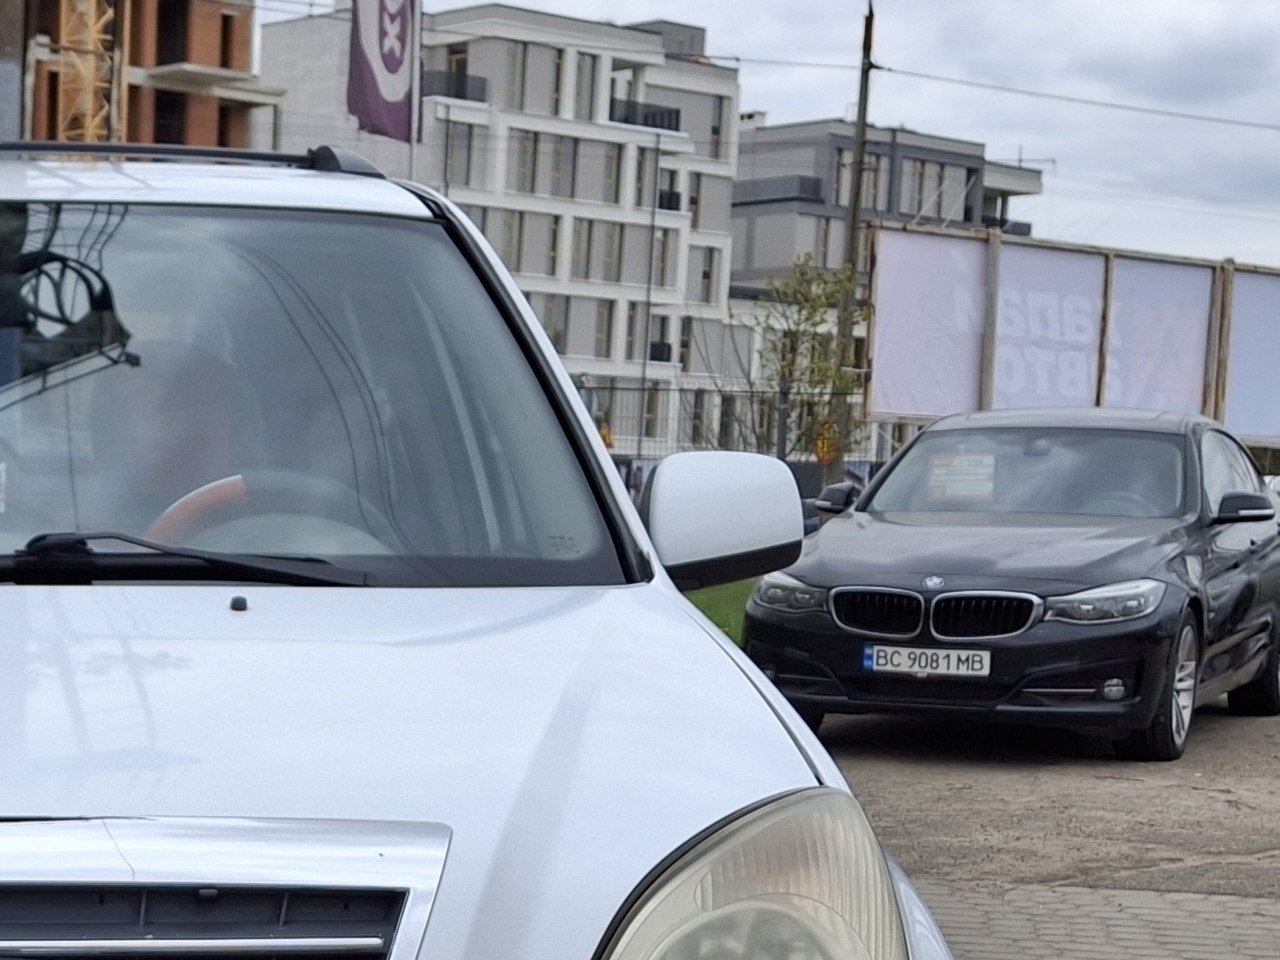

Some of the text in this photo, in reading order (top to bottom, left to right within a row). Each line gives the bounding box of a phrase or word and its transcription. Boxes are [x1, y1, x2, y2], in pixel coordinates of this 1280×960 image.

[875, 648, 902, 668] BC
[906, 651, 952, 670] 9081
[956, 653, 985, 672] MB
